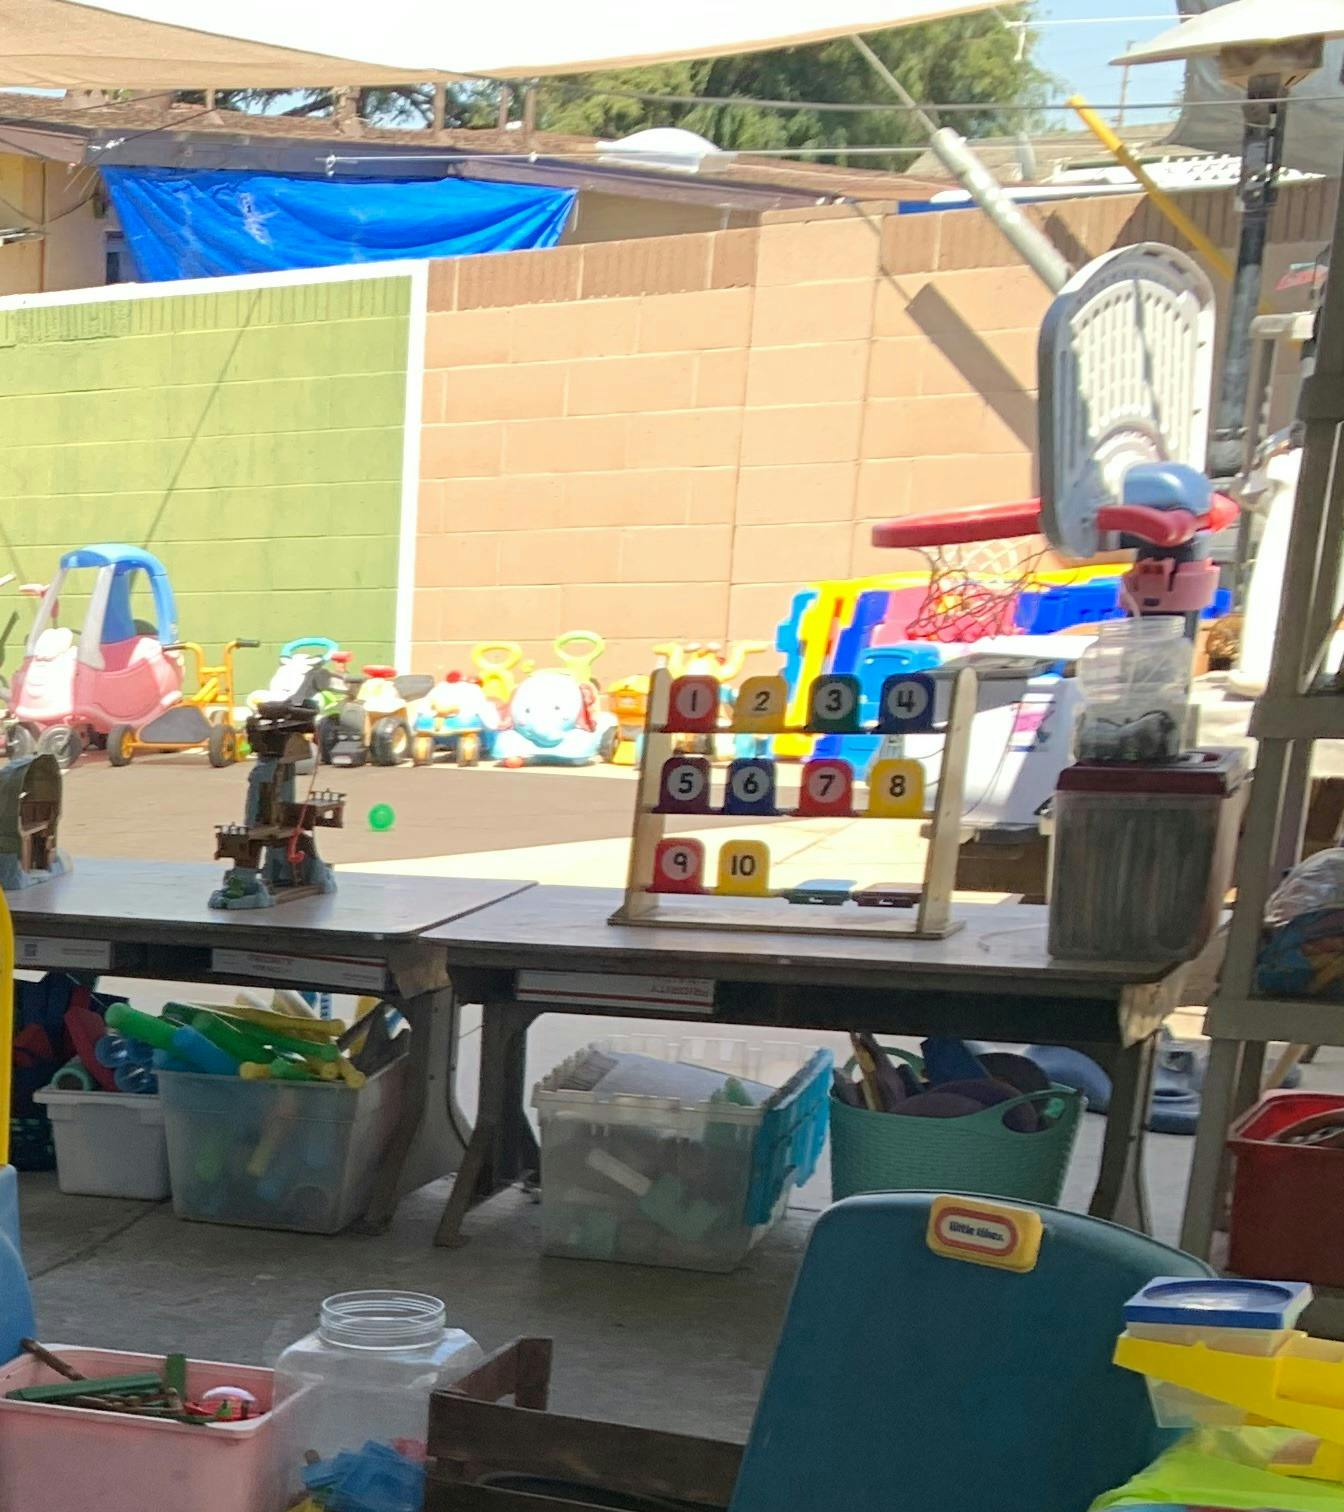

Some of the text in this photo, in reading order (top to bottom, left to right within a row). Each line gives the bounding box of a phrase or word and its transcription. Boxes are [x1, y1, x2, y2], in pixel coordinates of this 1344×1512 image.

[690, 689, 915, 712] 1 2 3 4
[678, 773, 905, 797] 5 6 7 8
[674, 853, 755, 876] 9 10
